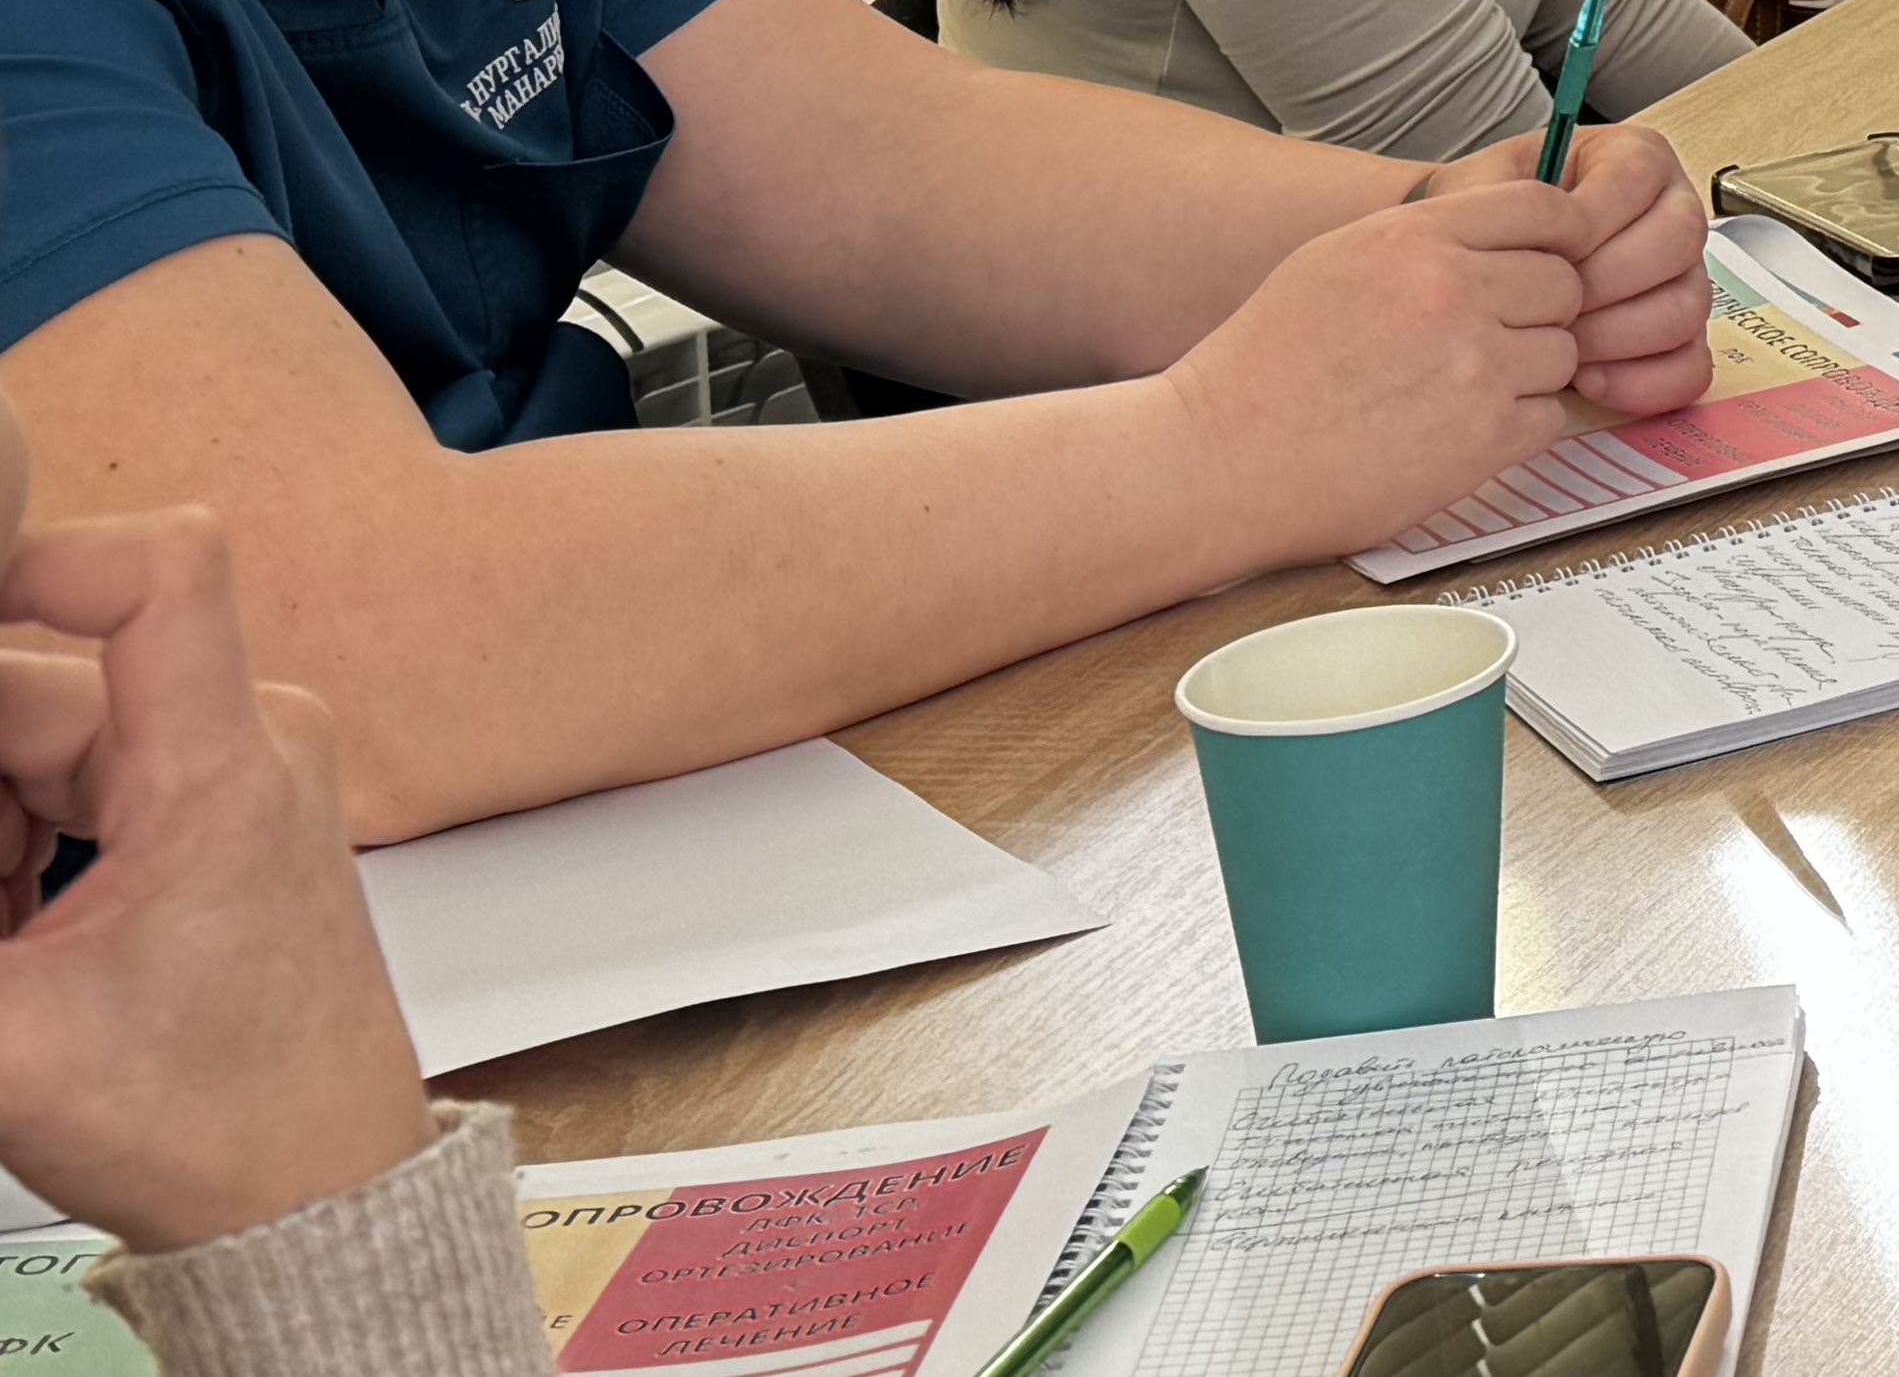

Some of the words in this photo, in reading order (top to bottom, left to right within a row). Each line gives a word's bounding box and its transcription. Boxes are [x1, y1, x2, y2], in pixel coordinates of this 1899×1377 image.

[520, 1144, 1027, 1231] ОПРОВОЖДЕНИЕ
[616, 1272, 935, 1336] ОПЕРАТИВНОЕ
[656, 1313, 858, 1357] ЛЕЧЕНИЕ
